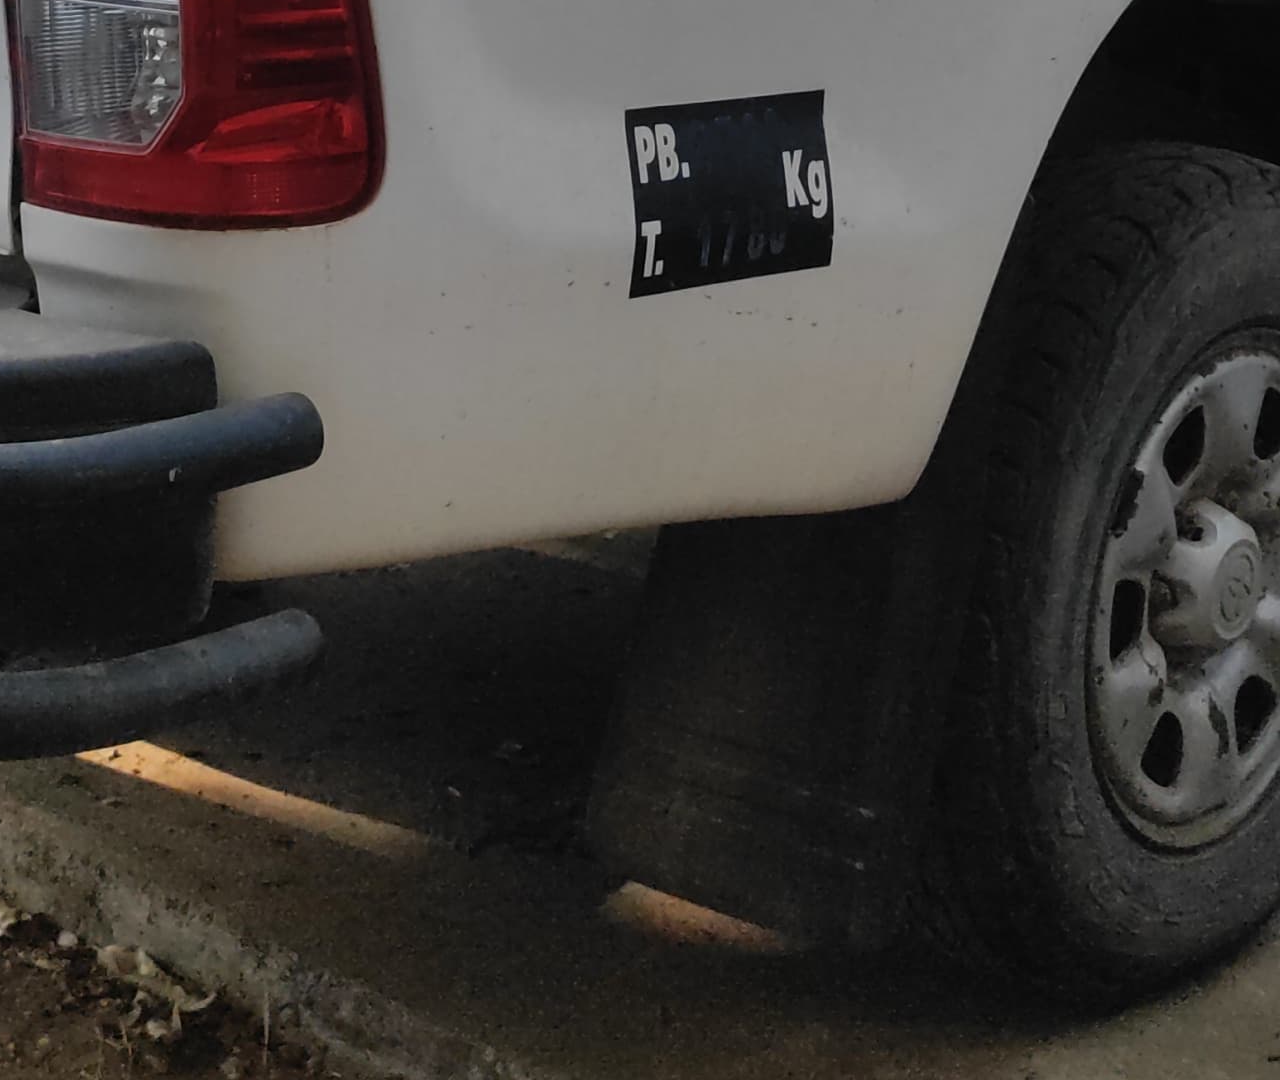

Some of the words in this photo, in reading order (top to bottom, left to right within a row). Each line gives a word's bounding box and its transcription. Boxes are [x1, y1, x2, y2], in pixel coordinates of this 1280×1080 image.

[633, 123, 691, 184] PB.
[782, 149, 828, 219] Kg
[641, 220, 664, 278] T.
